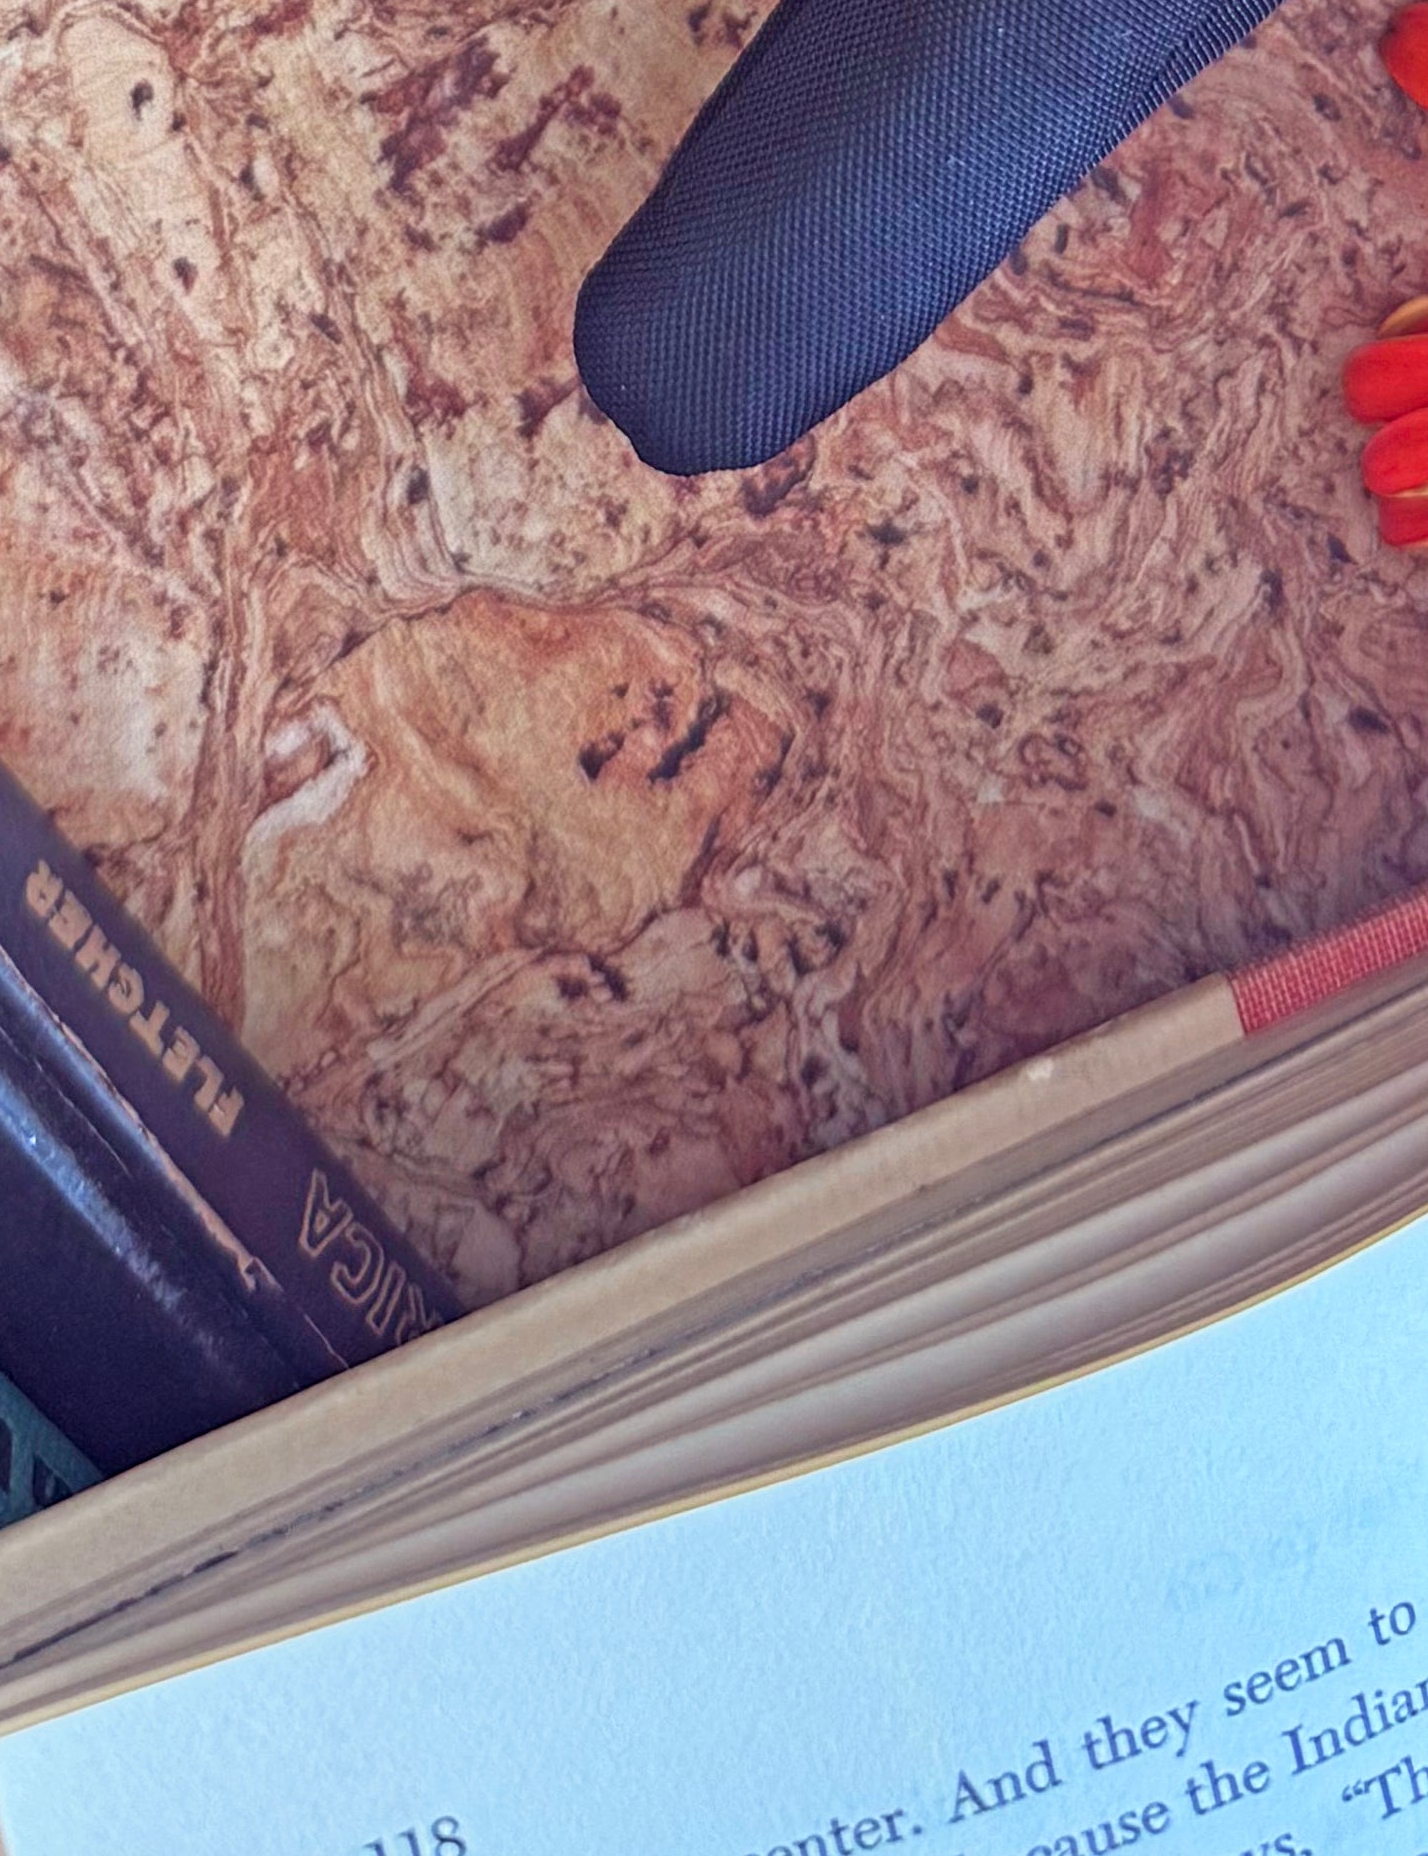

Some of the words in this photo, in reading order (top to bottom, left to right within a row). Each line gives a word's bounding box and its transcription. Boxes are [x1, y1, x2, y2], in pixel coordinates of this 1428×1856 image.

[23, 859, 245, 1138] FLETCHER
[299, 1168, 440, 1346] RICA
[948, 1739, 1063, 1824] And
[1082, 1700, 1199, 1770] they
[1224, 1638, 1352, 1717] seem
[1368, 1602, 1416, 1646] to
[1185, 1760, 1270, 1816] the
